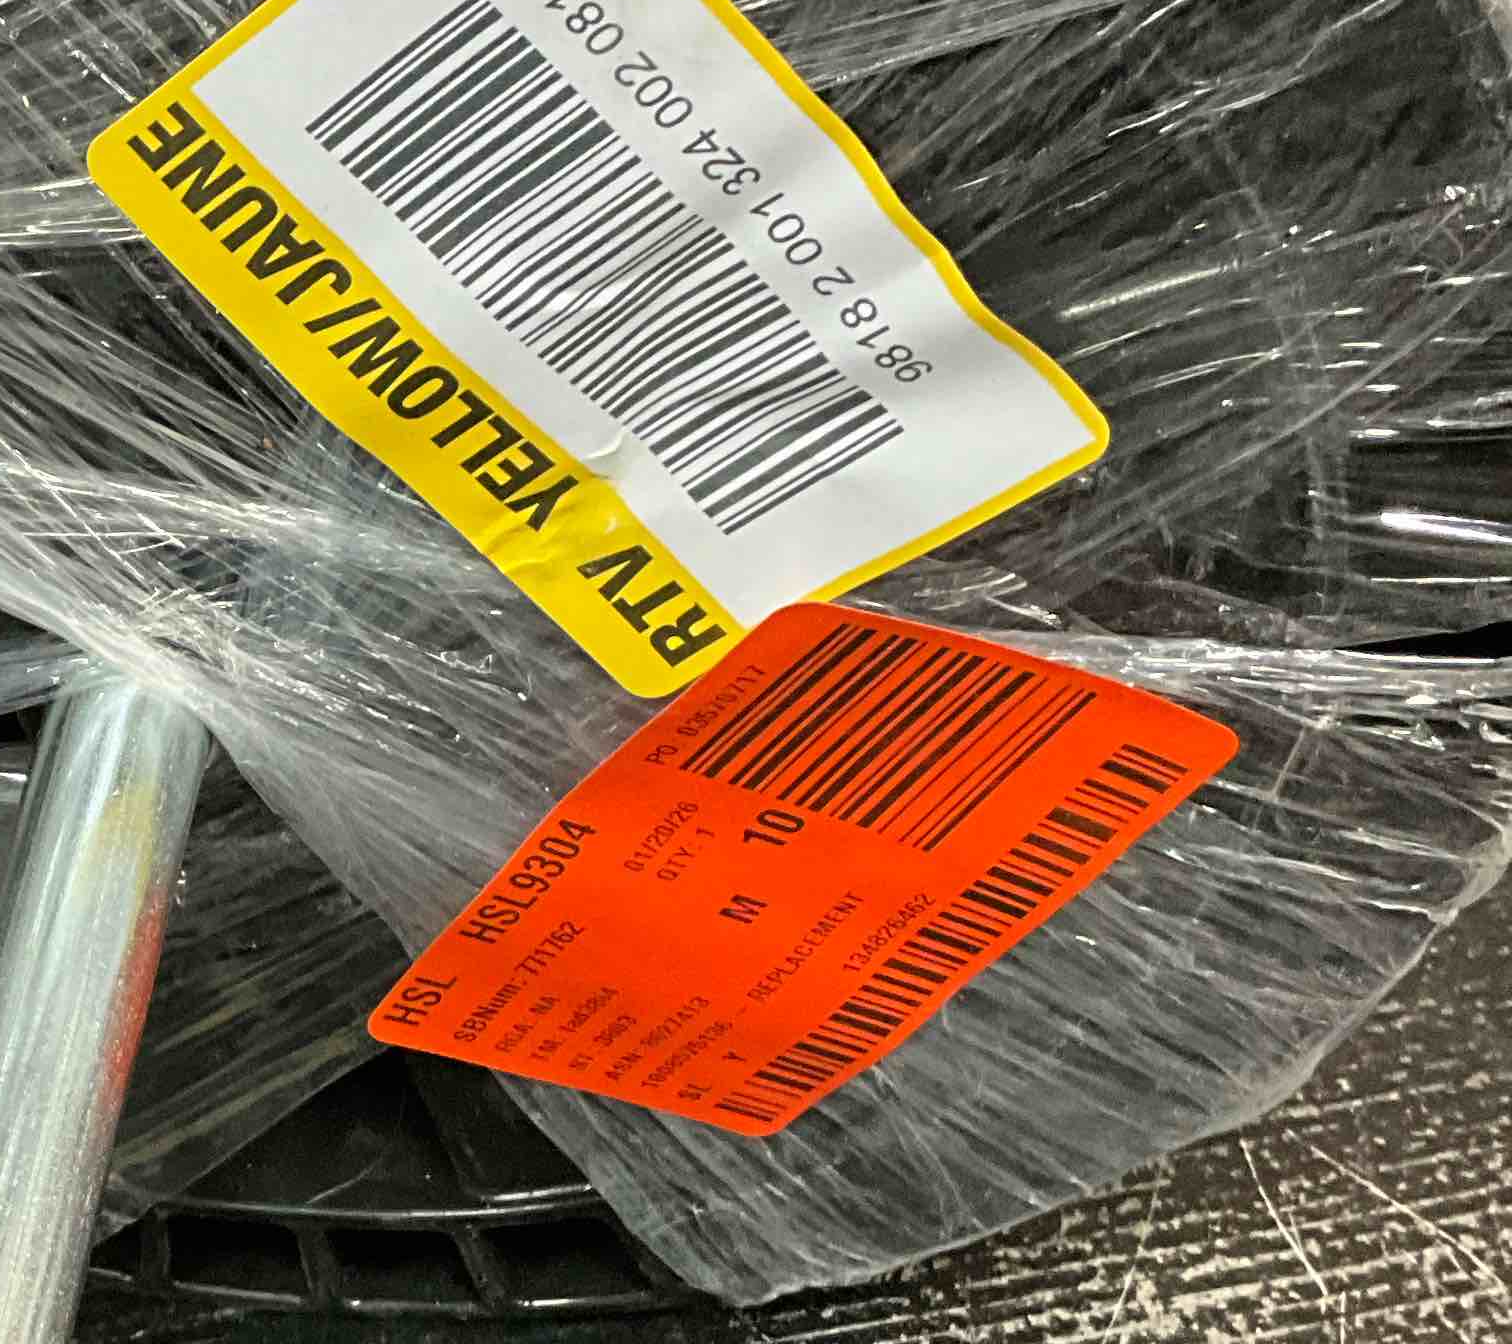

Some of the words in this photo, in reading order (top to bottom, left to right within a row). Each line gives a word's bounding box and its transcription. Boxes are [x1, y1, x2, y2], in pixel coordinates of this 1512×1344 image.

[614, 51, 693, 129] 002
[682, 128, 760, 195] 324
[750, 193, 823, 265] 001
[127, 102, 580, 531] YELLOW/JAUNE
[812, 266, 855, 296] 2
[840, 297, 933, 383] 9818
[577, 546, 727, 668] RTV
[744, 810, 804, 845] 10
[384, 976, 456, 1026] HSL
[459, 820, 595, 944] HSL9304
[720, 895, 767, 923] M
[747, 891, 864, 1000] REPLACEMENT
[844, 893, 936, 971] 134826462
[514, 922, 584, 976] 771762
